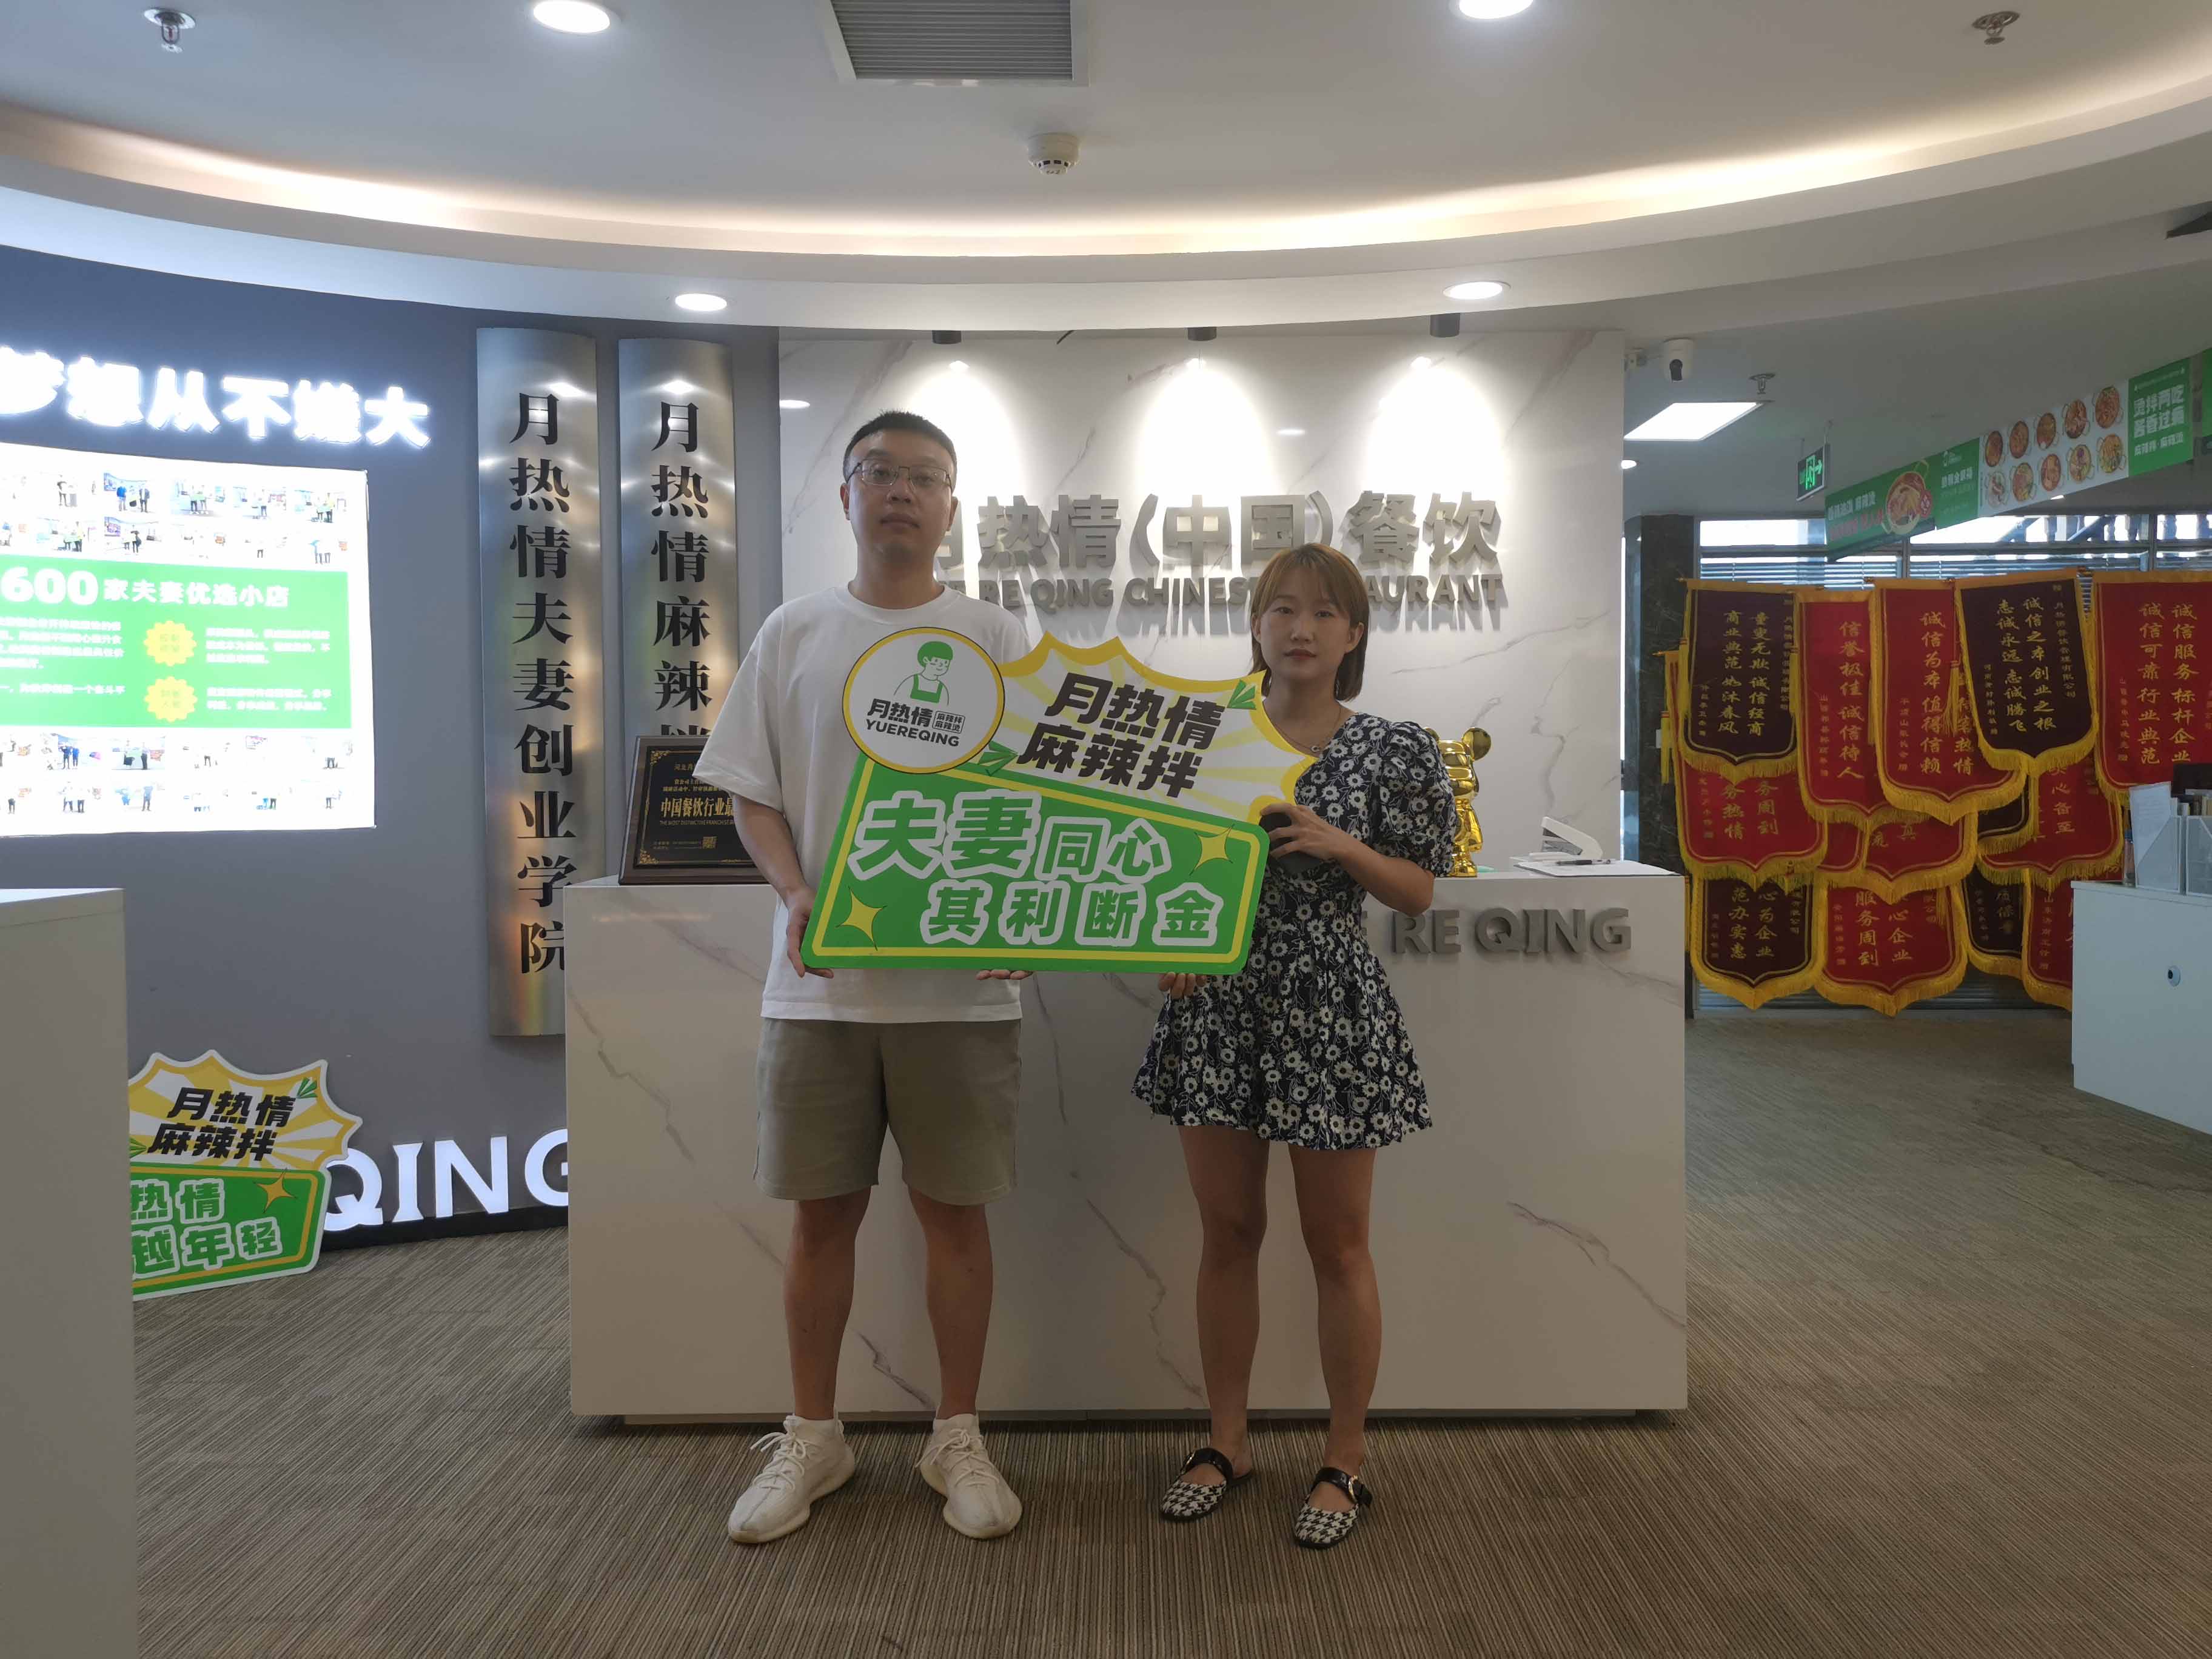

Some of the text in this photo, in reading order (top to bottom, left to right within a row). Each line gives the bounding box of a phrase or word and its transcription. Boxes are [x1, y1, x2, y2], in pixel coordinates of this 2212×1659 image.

[651, 401, 712, 735] 月热情麻辣
[1030, 577, 1114, 609] QING
[1364, 574, 1501, 602] AURANT
[509, 392, 577, 974] 月热情夫妻创业学院
[865, 719, 960, 747] YUEREQING
[866, 698, 933, 728] 月热情
[936, 712, 963, 724] 麻辣拌
[1044, 672, 1228, 750] 月热情
[1016, 722, 1203, 798] 麻辣拌
[850, 791, 1170, 882] 夫妻同心
[922, 882, 1222, 947] 其利断金
[1391, 909, 1462, 955] RE
[1475, 908, 1632, 954] QING
[167, 1087, 296, 1127] 月热情
[147, 1122, 278, 1162] 麻辣拌
